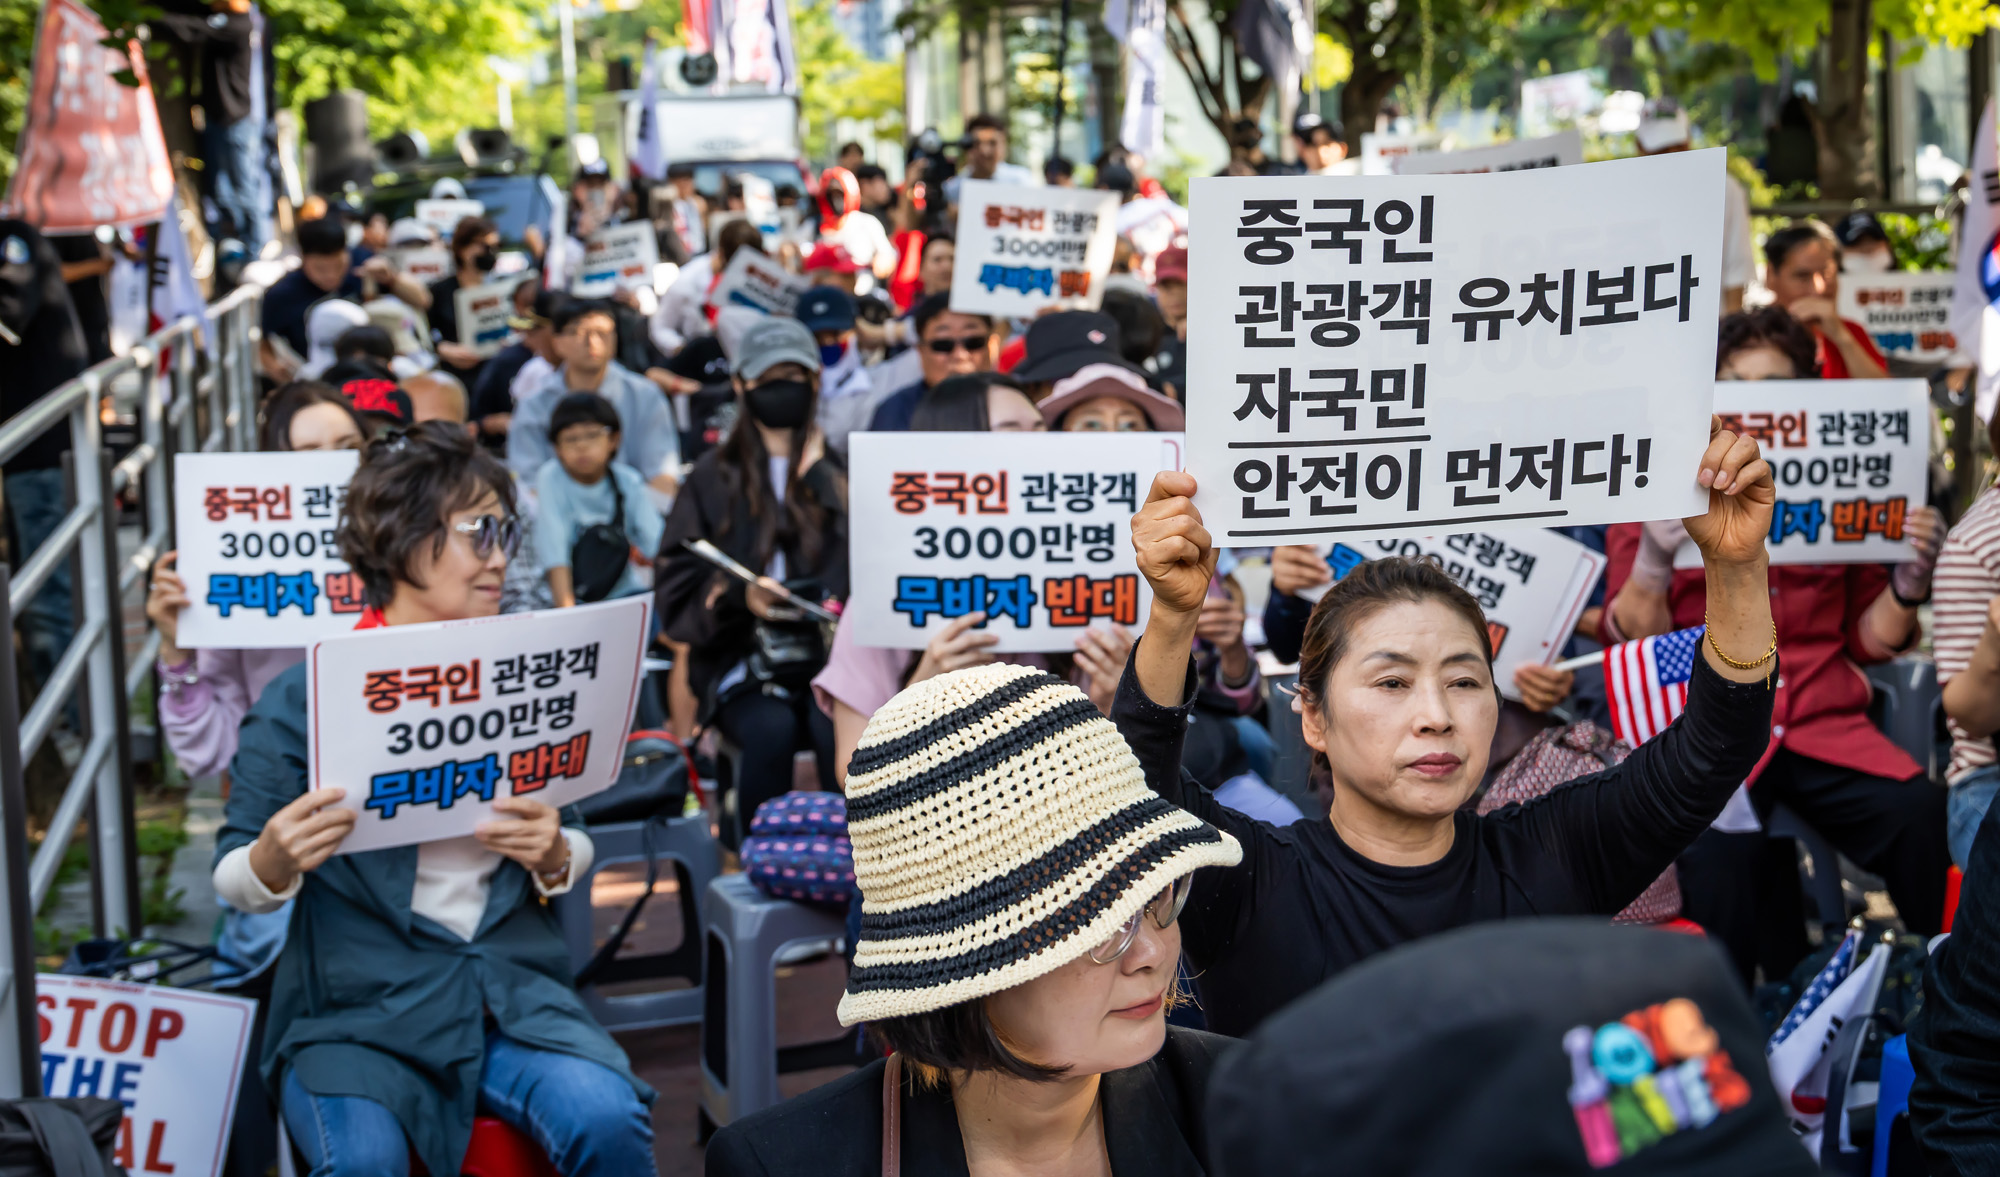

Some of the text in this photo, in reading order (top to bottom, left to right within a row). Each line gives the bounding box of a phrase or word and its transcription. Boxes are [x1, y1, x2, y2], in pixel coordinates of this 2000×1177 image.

[1237, 195, 1434, 265] 중국인
[1235, 254, 1699, 348] 관광객 유치보다
[1232, 363, 1427, 433] 자국민
[1816, 409, 1909, 446] 관광객
[890, 470, 1137, 515] 중국인 관광객
[1233, 433, 1651, 519] 안전이 먼저다!
[1770, 453, 1892, 488] 00만명
[204, 484, 349, 522] 중국인 관
[1831, 496, 1908, 543] 반대
[914, 522, 1116, 562] 3000만명
[206, 570, 367, 617] 무비자 반
[893, 574, 1138, 628] 무비자 반대
[364, 641, 601, 715] 중국인 관광객
[387, 689, 578, 755] 3000만명
[364, 729, 591, 820] 무비자 반대
[37, 995, 185, 1058] STOP
[41, 1054, 144, 1109] THE
[114, 1116, 175, 1174] AL
